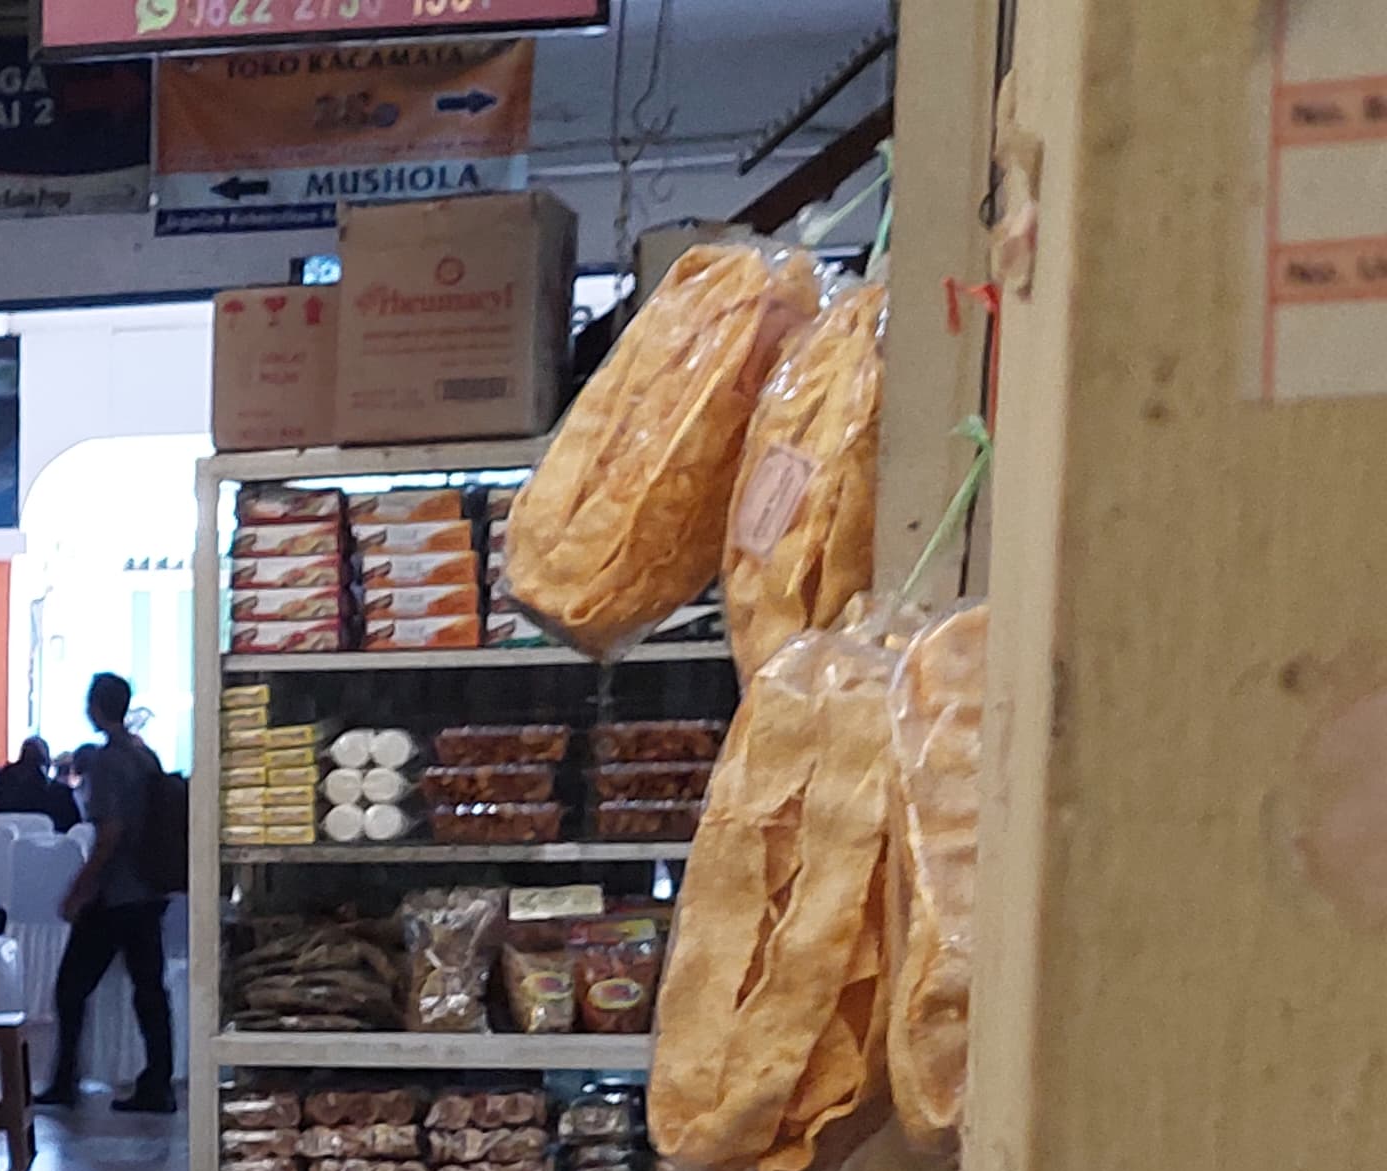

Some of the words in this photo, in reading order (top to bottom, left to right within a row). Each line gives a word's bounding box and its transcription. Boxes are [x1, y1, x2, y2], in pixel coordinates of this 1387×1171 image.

[228, 56, 301, 79] TOKO
[309, 45, 464, 75] KACAMATA
[34, 98, 55, 127] 2
[306, 163, 479, 198] MUSHOLA
